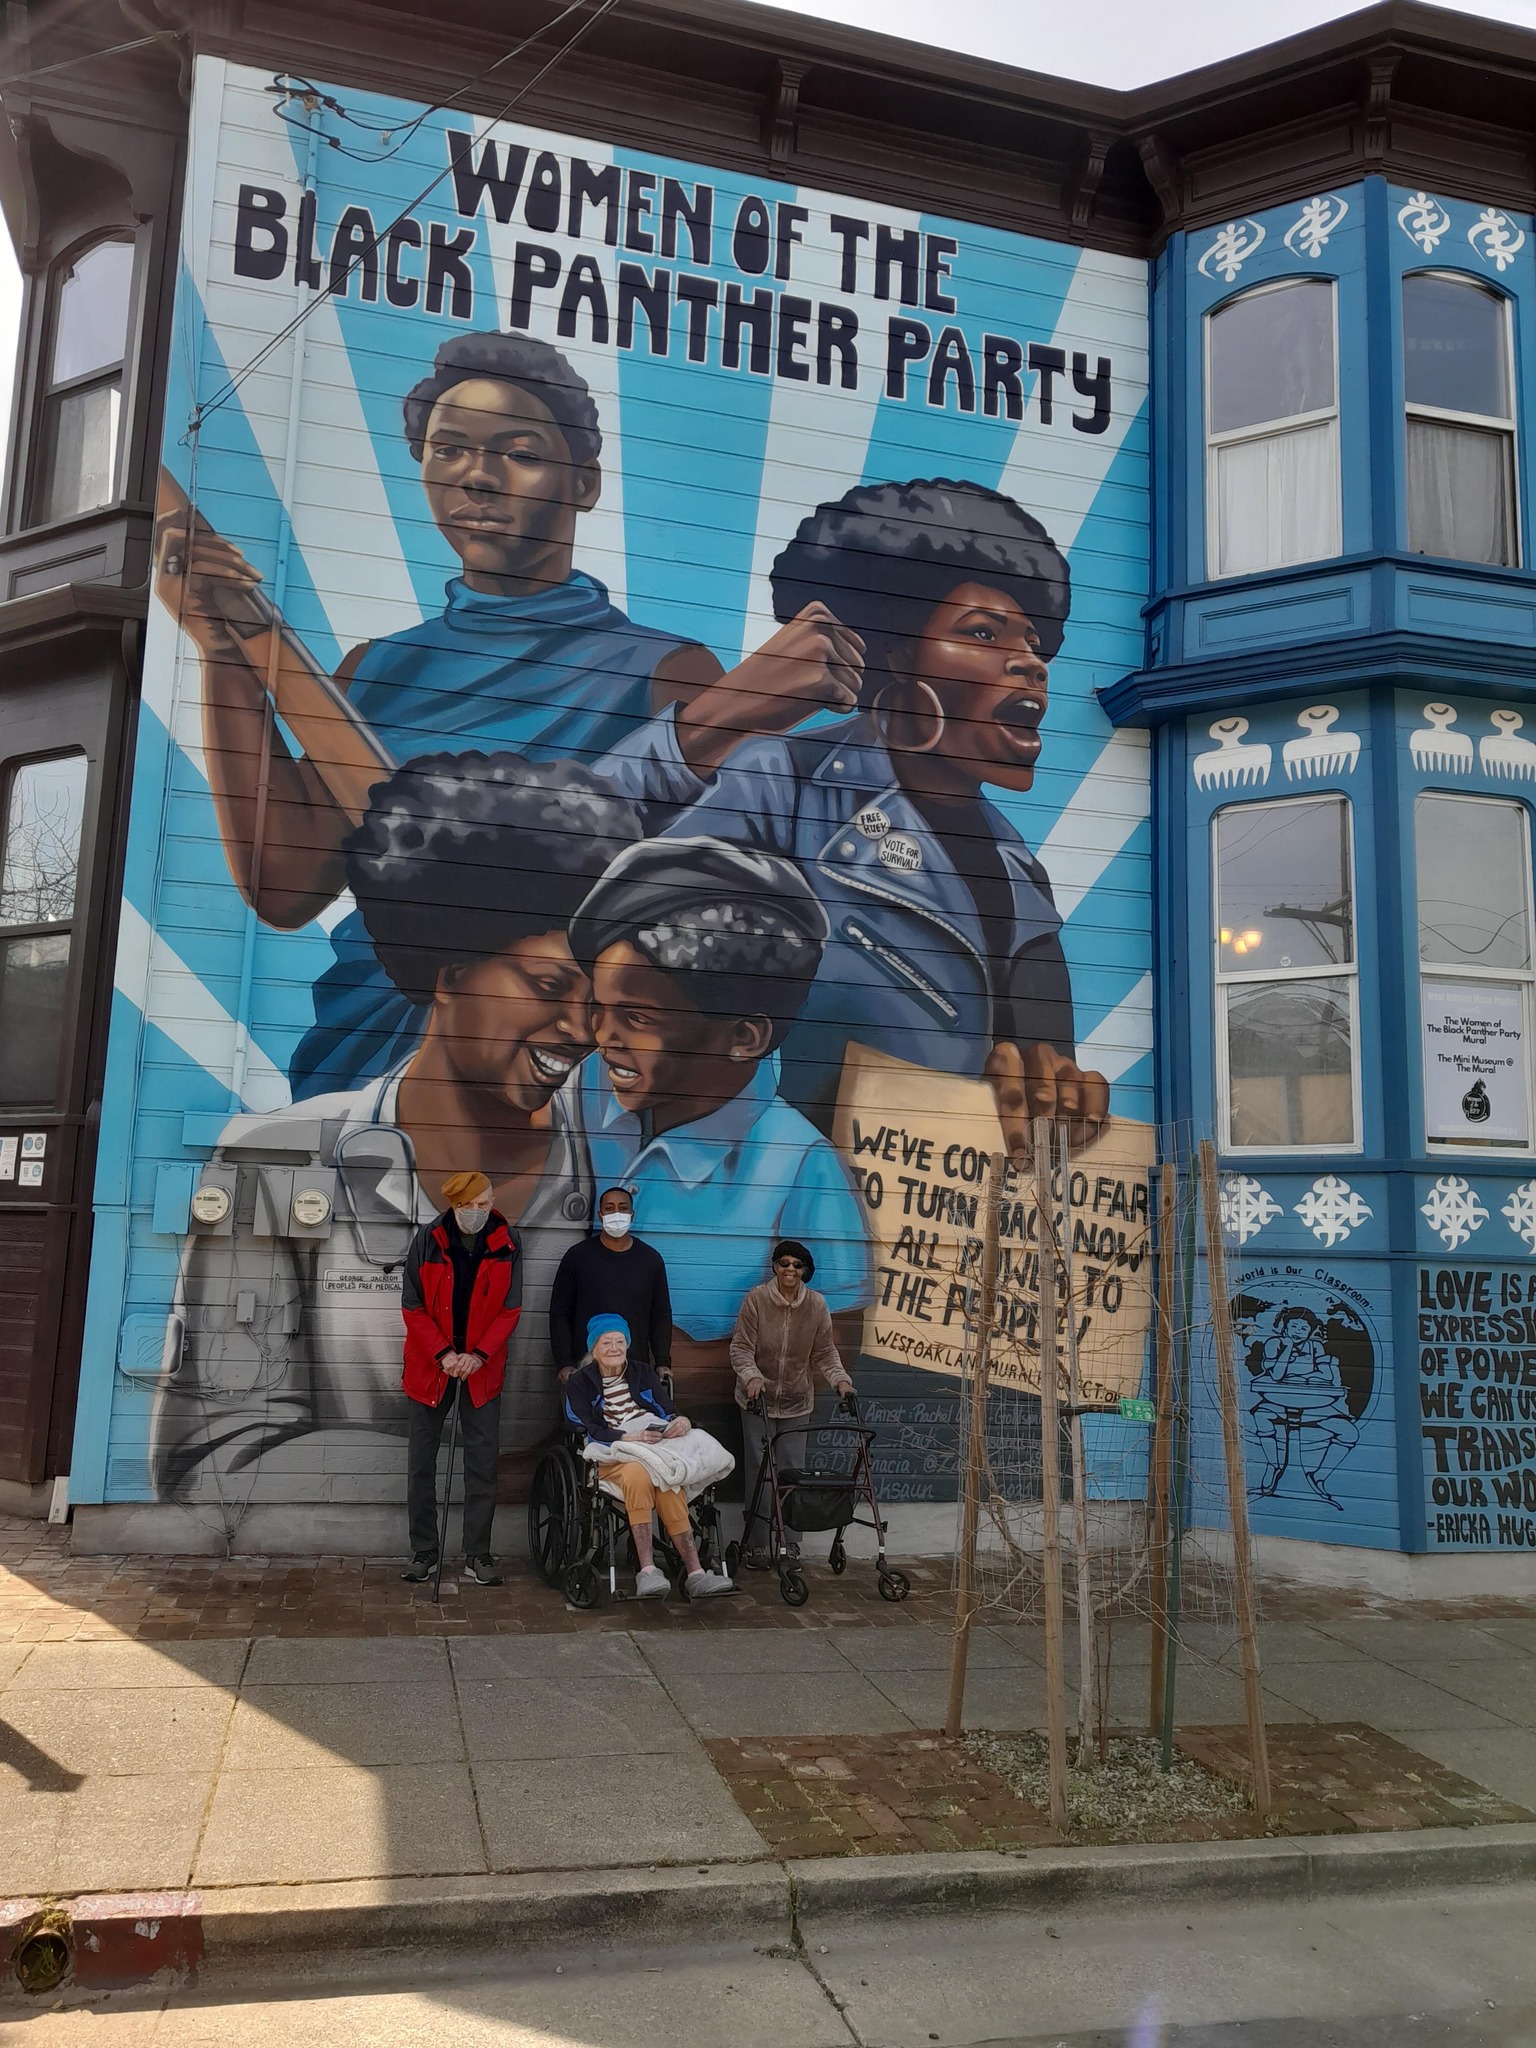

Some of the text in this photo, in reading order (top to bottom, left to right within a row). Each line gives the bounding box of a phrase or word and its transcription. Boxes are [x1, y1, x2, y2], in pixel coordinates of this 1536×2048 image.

[447, 129, 958, 314] WOMEN OF THE
[234, 183, 1112, 434] BLACK PANTHER PARTY
[860, 812, 882, 825] FREE
[863, 822, 887, 834] HUEY
[884, 838, 919, 859] VOTE FOR
[1427, 1024, 1521, 1040] The Black Panther Party
[1444, 1016, 1502, 1028] The Women of
[1462, 1034, 1487, 1044] Mural
[1437, 1053, 1452, 1063] The
[1453, 1054, 1470, 1064] Mini
[1472, 1055, 1505, 1066] Museum
[1456, 1064, 1496, 1074] The Mural
[852, 1119, 935, 1172] WE'VE
[1093, 1176, 1149, 1226] FAR
[898, 1176, 978, 1230] TURN
[1072, 1218, 1150, 1273] NOW
[891, 1225, 942, 1270] ALL
[1083, 1265, 1123, 1314] TO
[1271, 1266, 1279, 1275] is
[1286, 1265, 1303, 1275] Our
[877, 1266, 938, 1322] THE
[1420, 1269, 1493, 1314] LOVE
[1501, 1272, 1522, 1307] IS
[1419, 1306, 1536, 1344] EXPRESSI
[1421, 1347, 1449, 1377] OF
[1420, 1382, 1465, 1419] WE
[1470, 1385, 1514, 1422] CAN
[1422, 1425, 1536, 1473] TRANS
[1432, 1477, 1488, 1507] OUR
